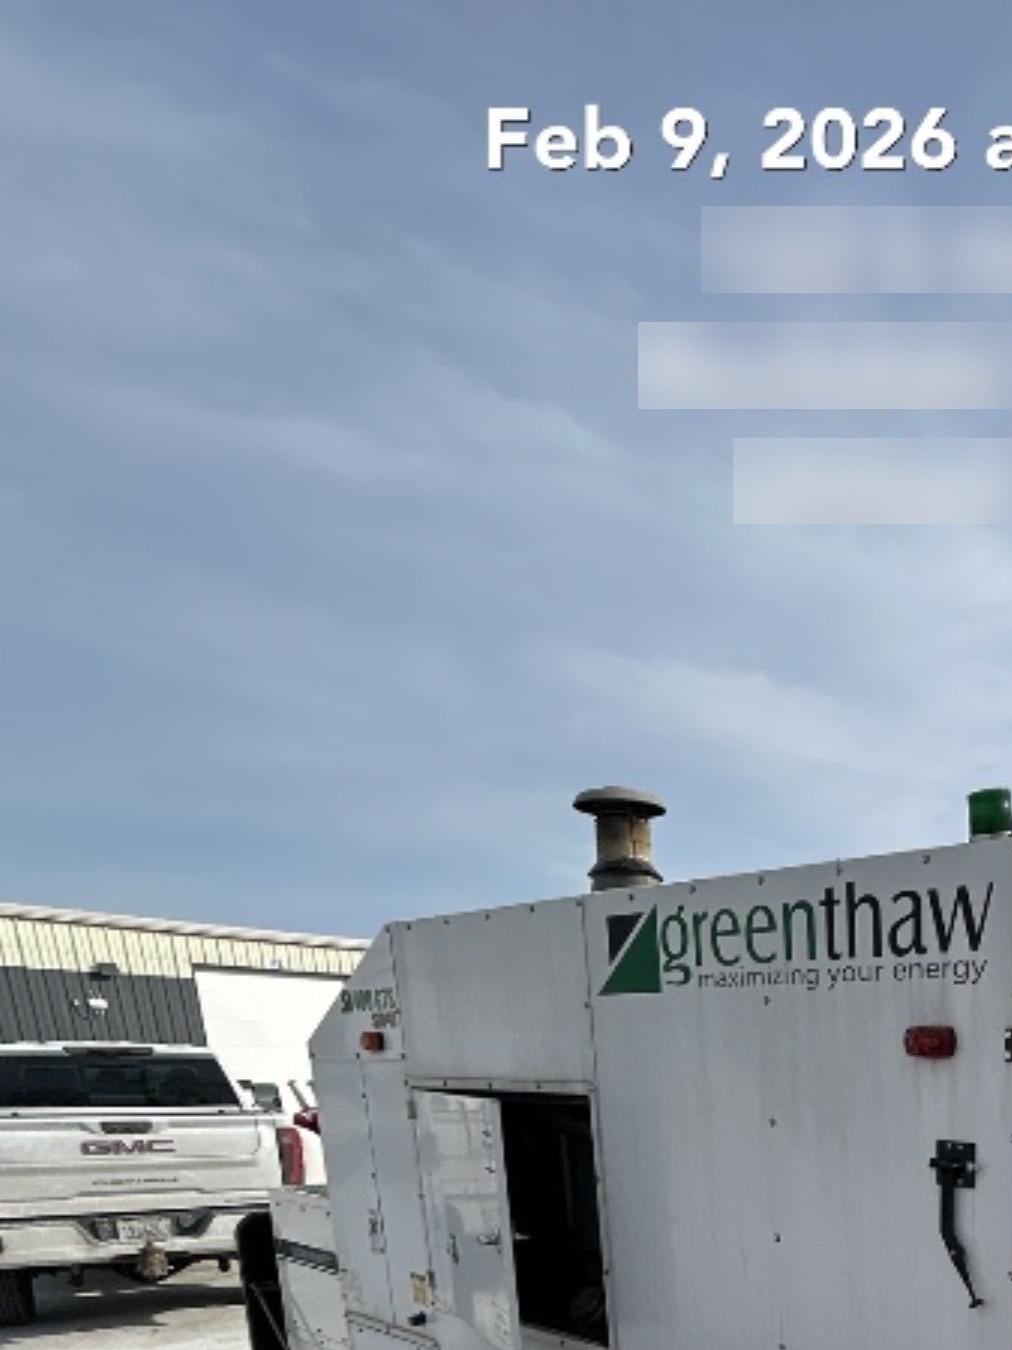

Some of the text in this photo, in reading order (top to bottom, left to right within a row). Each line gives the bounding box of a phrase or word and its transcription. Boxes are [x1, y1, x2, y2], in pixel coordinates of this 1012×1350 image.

[660, 881, 995, 986] greenthaw
[698, 957, 989, 990] maximizing your energy
[80, 1139, 176, 1155] GMC
